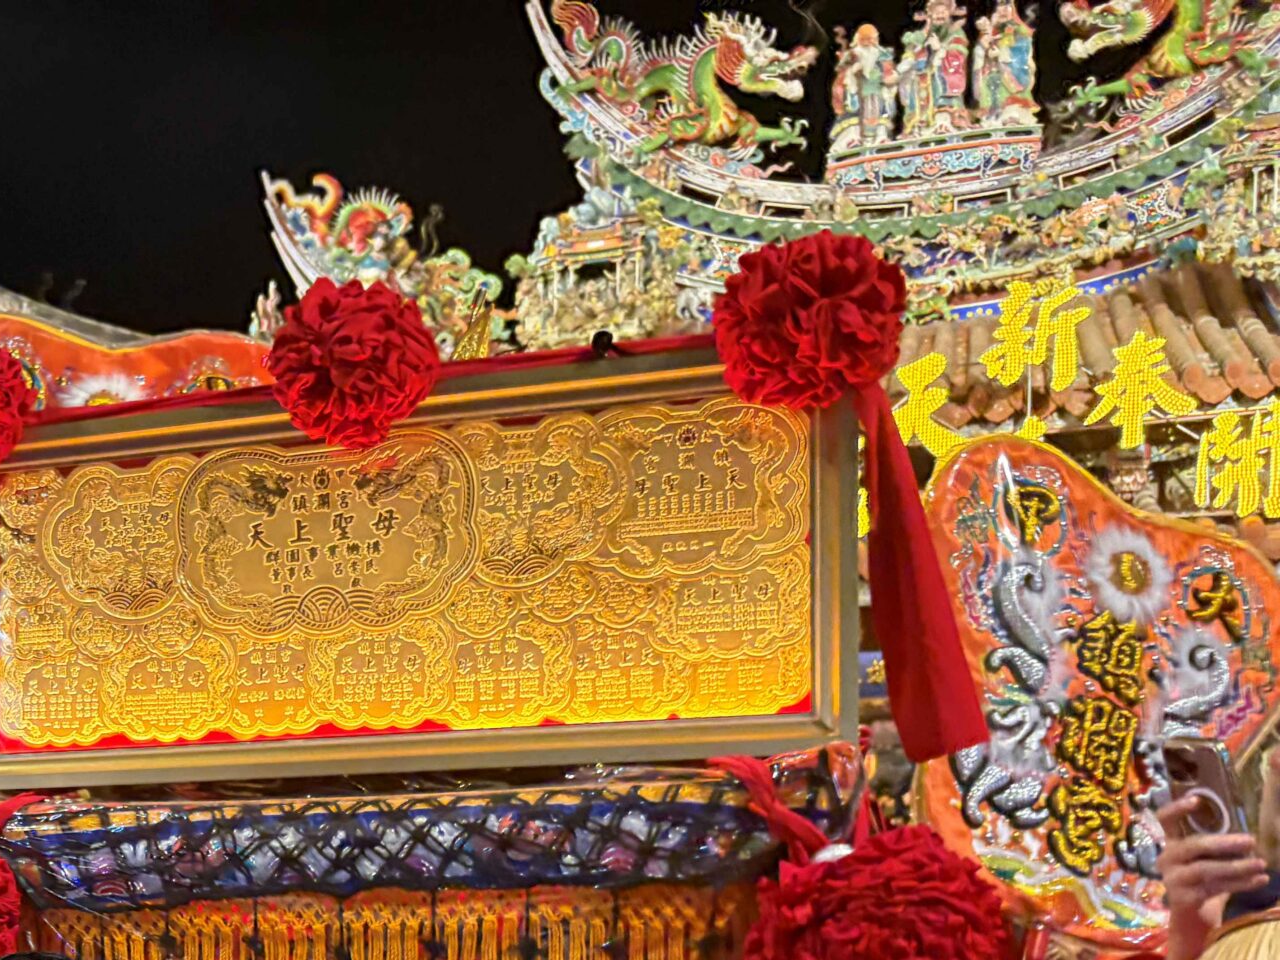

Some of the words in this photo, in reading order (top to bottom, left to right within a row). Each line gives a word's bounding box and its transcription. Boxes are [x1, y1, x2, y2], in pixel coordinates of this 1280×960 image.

[979, 281, 1091, 392] 新
[291, 490, 353, 514] 鎮瀾宮
[247, 508, 400, 551] 天上聖母
